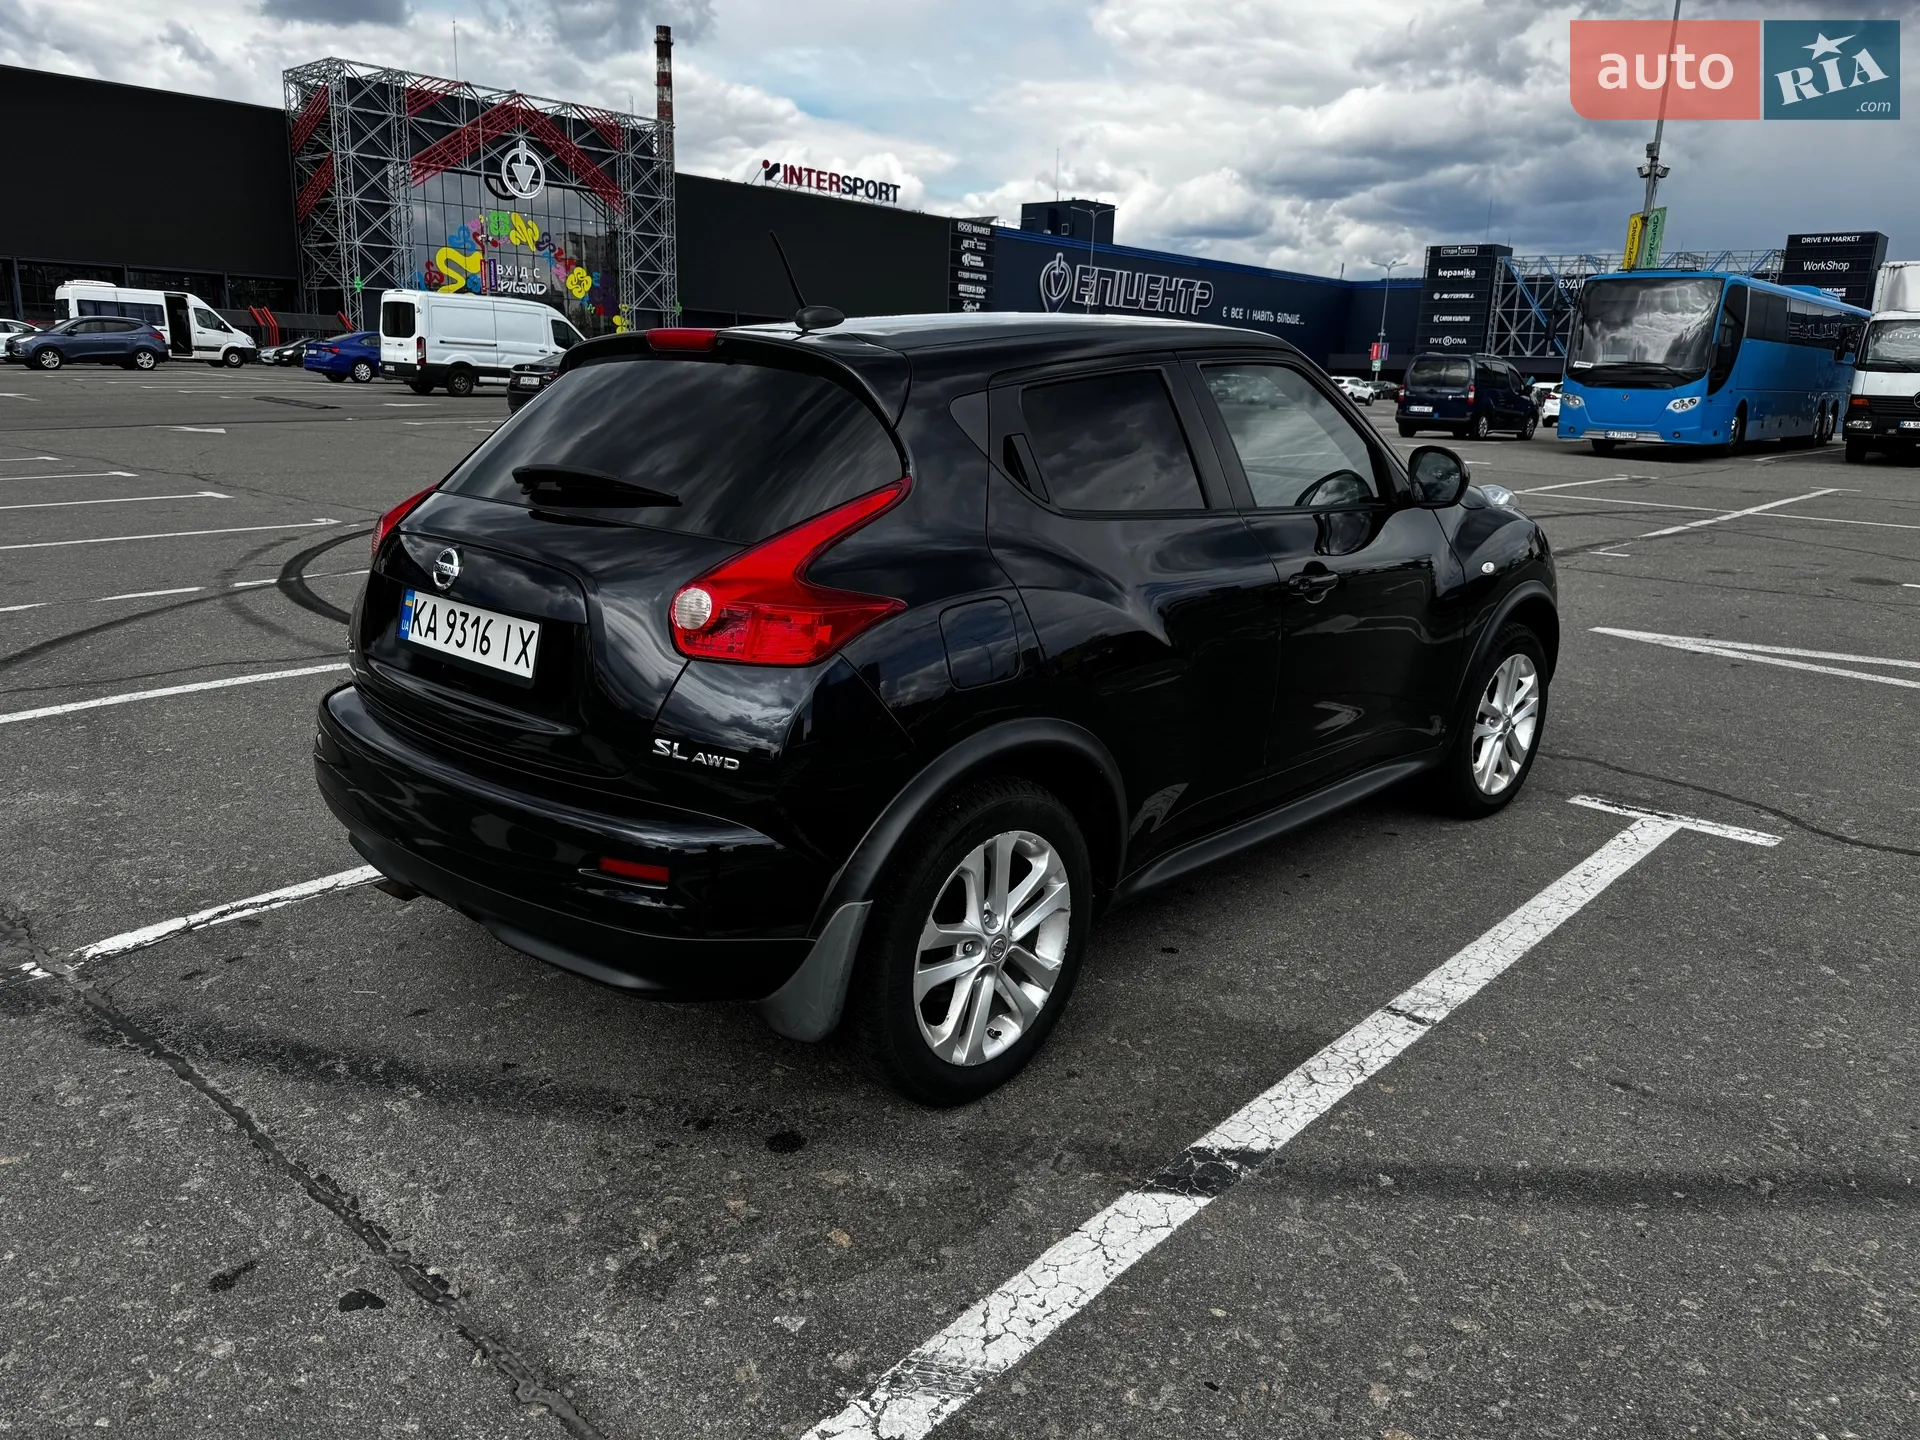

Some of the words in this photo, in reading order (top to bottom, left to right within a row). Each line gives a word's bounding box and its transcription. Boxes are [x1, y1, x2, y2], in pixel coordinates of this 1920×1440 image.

[783, 163, 901, 203] INTERSPORT
[957, 221, 972, 233] FOOD
[972, 225, 991, 236] MARKET
[1801, 236, 1822, 244] DRIVE
[1831, 235, 1861, 243] MARKET
[496, 264, 529, 279] ВХІД
[1803, 260, 1850, 272] WorkShop
[1072, 264, 1214, 315] ЕПІЦЕНТР
[1222, 306, 1228, 318] Є
[1230, 307, 1244, 319] ВСЕ
[1252, 309, 1275, 322] НАВІТЬ
[401, 620, 409, 631] UA
[411, 598, 437, 641] KA
[444, 608, 494, 656] 9316
[503, 624, 536, 669] IX
[652, 738, 688, 760] SL
[691, 752, 740, 770] AWD
